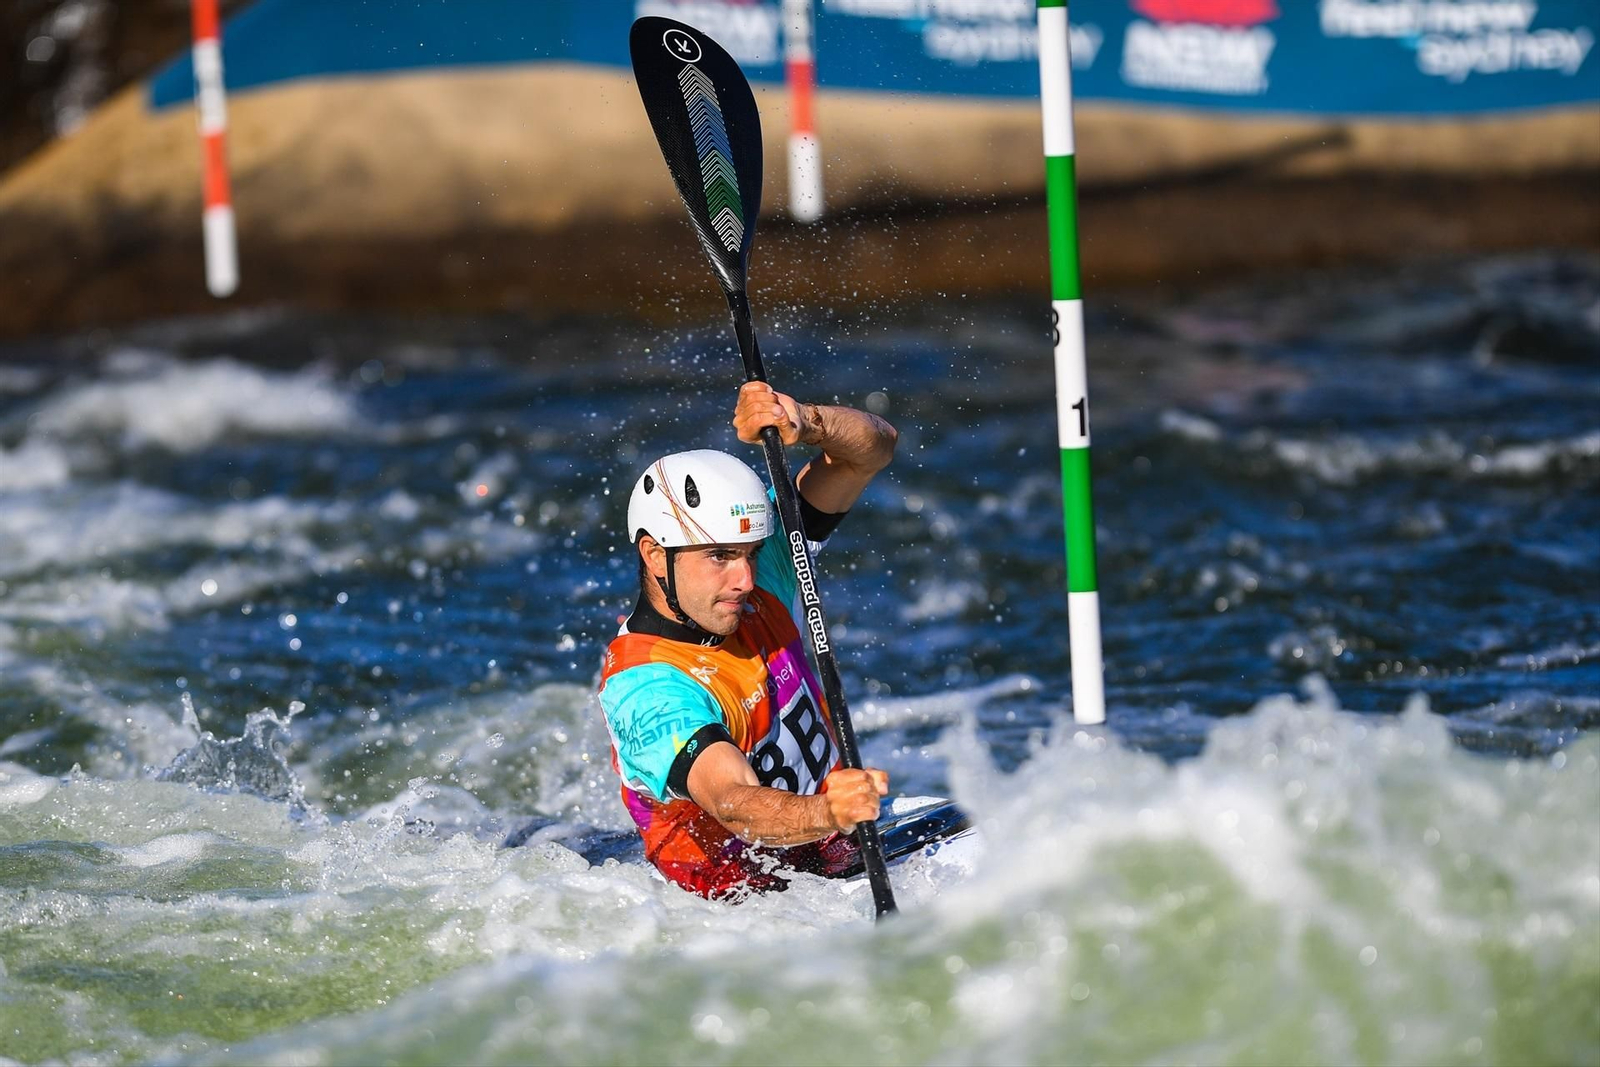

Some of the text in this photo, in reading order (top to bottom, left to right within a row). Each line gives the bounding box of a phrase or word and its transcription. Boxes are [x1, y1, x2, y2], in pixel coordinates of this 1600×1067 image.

[1072, 397, 1086, 437] 1
[790, 530, 829, 654] raab paddles
[741, 683, 766, 714] feel
